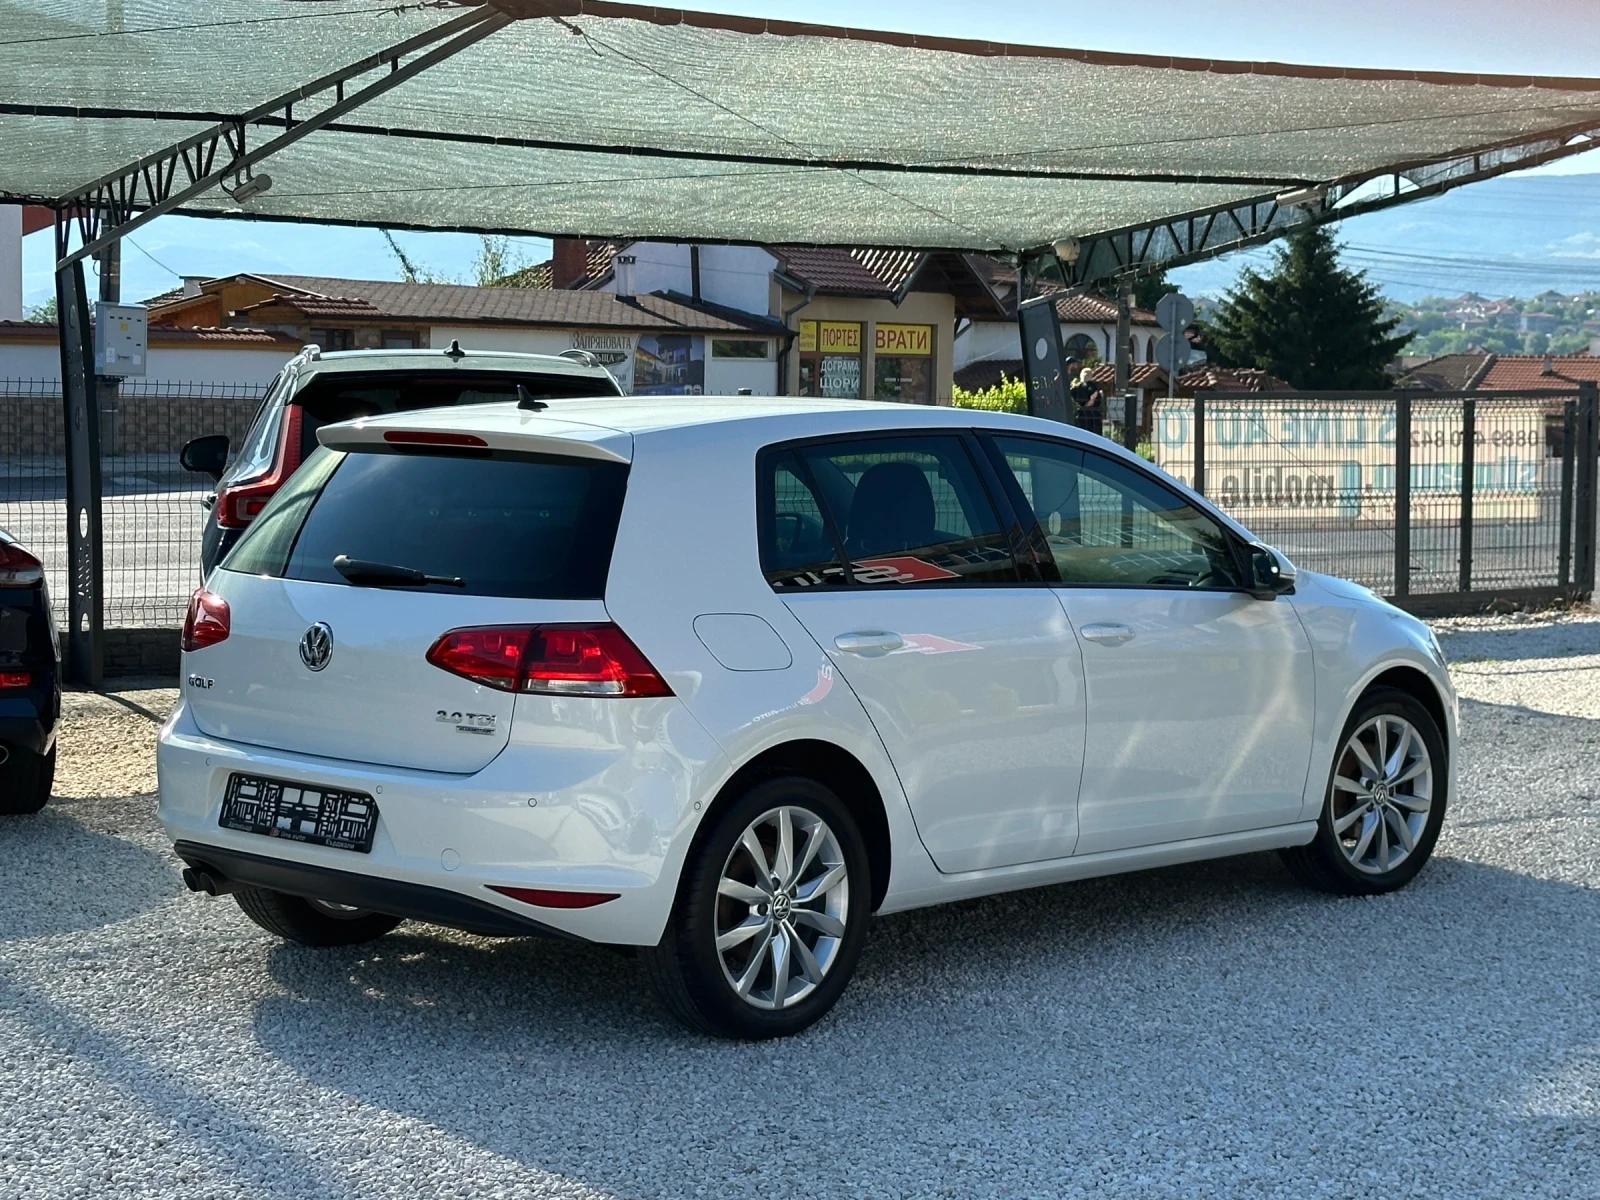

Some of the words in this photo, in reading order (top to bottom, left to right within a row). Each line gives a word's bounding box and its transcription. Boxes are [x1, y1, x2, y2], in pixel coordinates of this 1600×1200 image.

[875, 329, 927, 350] ВРАТИ
[820, 359, 859, 373] ДОГРАМА
[819, 377, 859, 391] ЩОРИ
[188, 673, 215, 690] GOLF
[435, 709, 463, 724] 2.0
